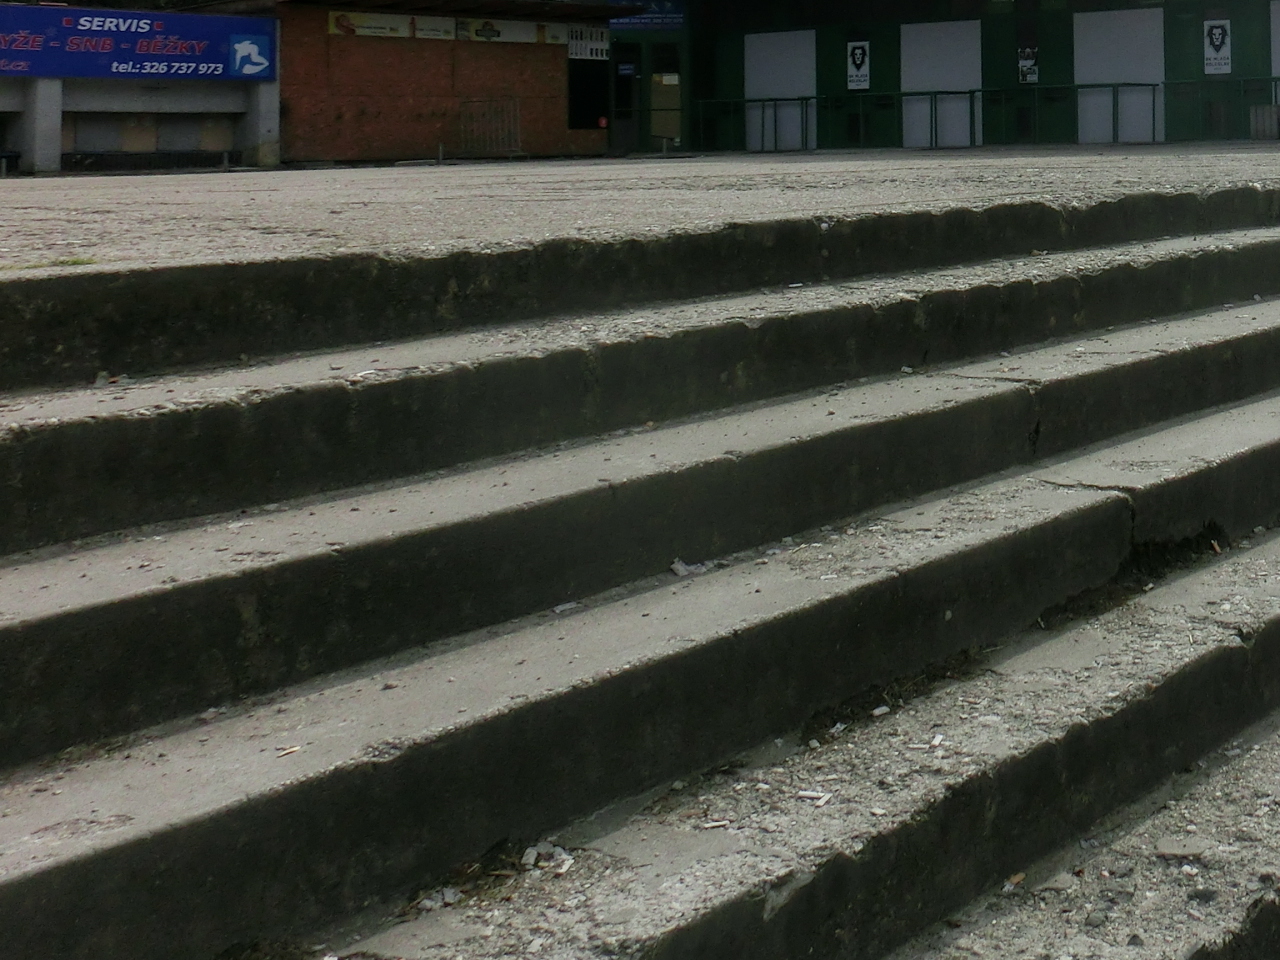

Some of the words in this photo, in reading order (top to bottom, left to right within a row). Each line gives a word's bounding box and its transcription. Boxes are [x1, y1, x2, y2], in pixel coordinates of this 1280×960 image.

[77, 16, 151, 33] SERVIS
[0, 29, 44, 51] YŽE
[65, 36, 114, 52] SNB
[135, 34, 209, 56] BĚŽKY
[141, 61, 170, 74] 326
[171, 62, 197, 74] 737
[198, 63, 224, 75] 973
